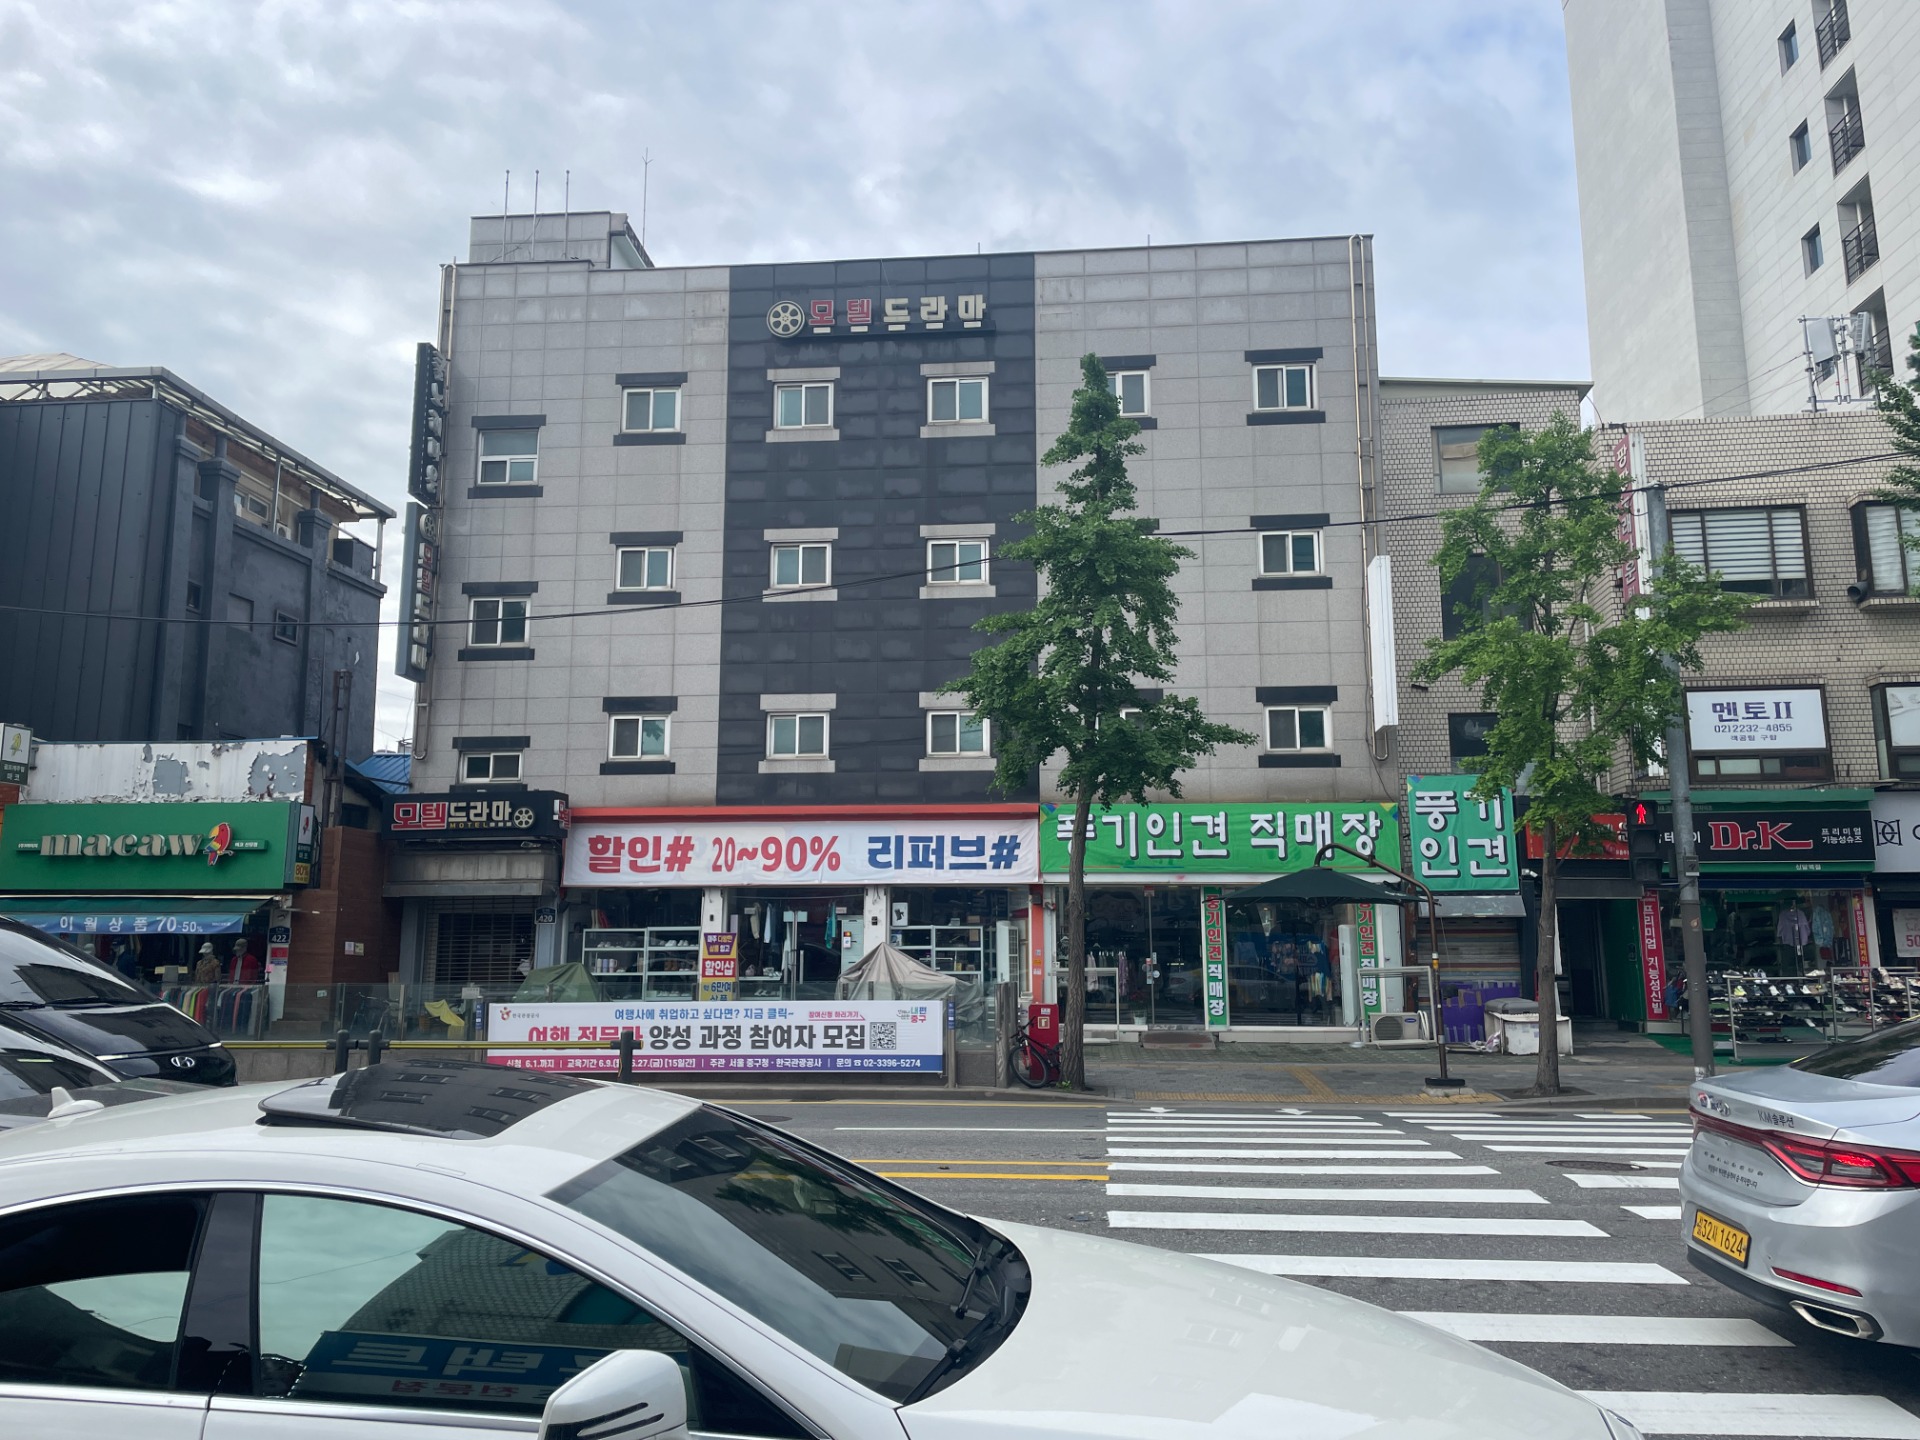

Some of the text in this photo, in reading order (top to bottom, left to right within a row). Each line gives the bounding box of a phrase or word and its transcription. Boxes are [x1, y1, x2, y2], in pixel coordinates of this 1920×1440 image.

[808, 294, 987, 325] 모텔 드라마
[1714, 723, 1793, 733] 02)2232-4855
[391, 800, 512, 831] 모텔 드라마
[40, 834, 203, 856] macaw
[1250, 810, 1380, 860] 직매장
[1708, 821, 1814, 850] Dr.K
[1821, 836, 1863, 844] 기능성슈즈
[588, 834, 1021, 873] 할인# 20~90% 리퍼브#
[1420, 835, 1507, 876] 인견
[538, 914, 553, 923] 420
[271, 934, 287, 943] 422
[705, 960, 734, 976] 할인샵
[1208, 964, 1225, 1016] 직매장
[615, 1007, 794, 1020] 여행사에 취업하고 싶다면? 지금 클릭~
[911, 1015, 927, 1023] 중구
[649, 1025, 691, 1049] 양성
[699, 1025, 742, 1049] 과정
[749, 1025, 816, 1049] 참여자
[822, 1025, 865, 1049] 모집
[525, 1059, 554, 1068] 6.1.까지
[567, 1059, 597, 1068] 교육기간
[709, 1058, 725, 1068] 주관
[729, 1058, 745, 1068] 서울
[746, 1058, 769, 1068] 중구청
[776, 1058, 822, 1068] 한국관광공사
[836, 1058, 851, 1068] 문의
[863, 1058, 921, 1067] 02-3396-5274
[1757, 1110, 1795, 1128] KM솔루션
[1720, 1228, 1744, 1257] 1624
